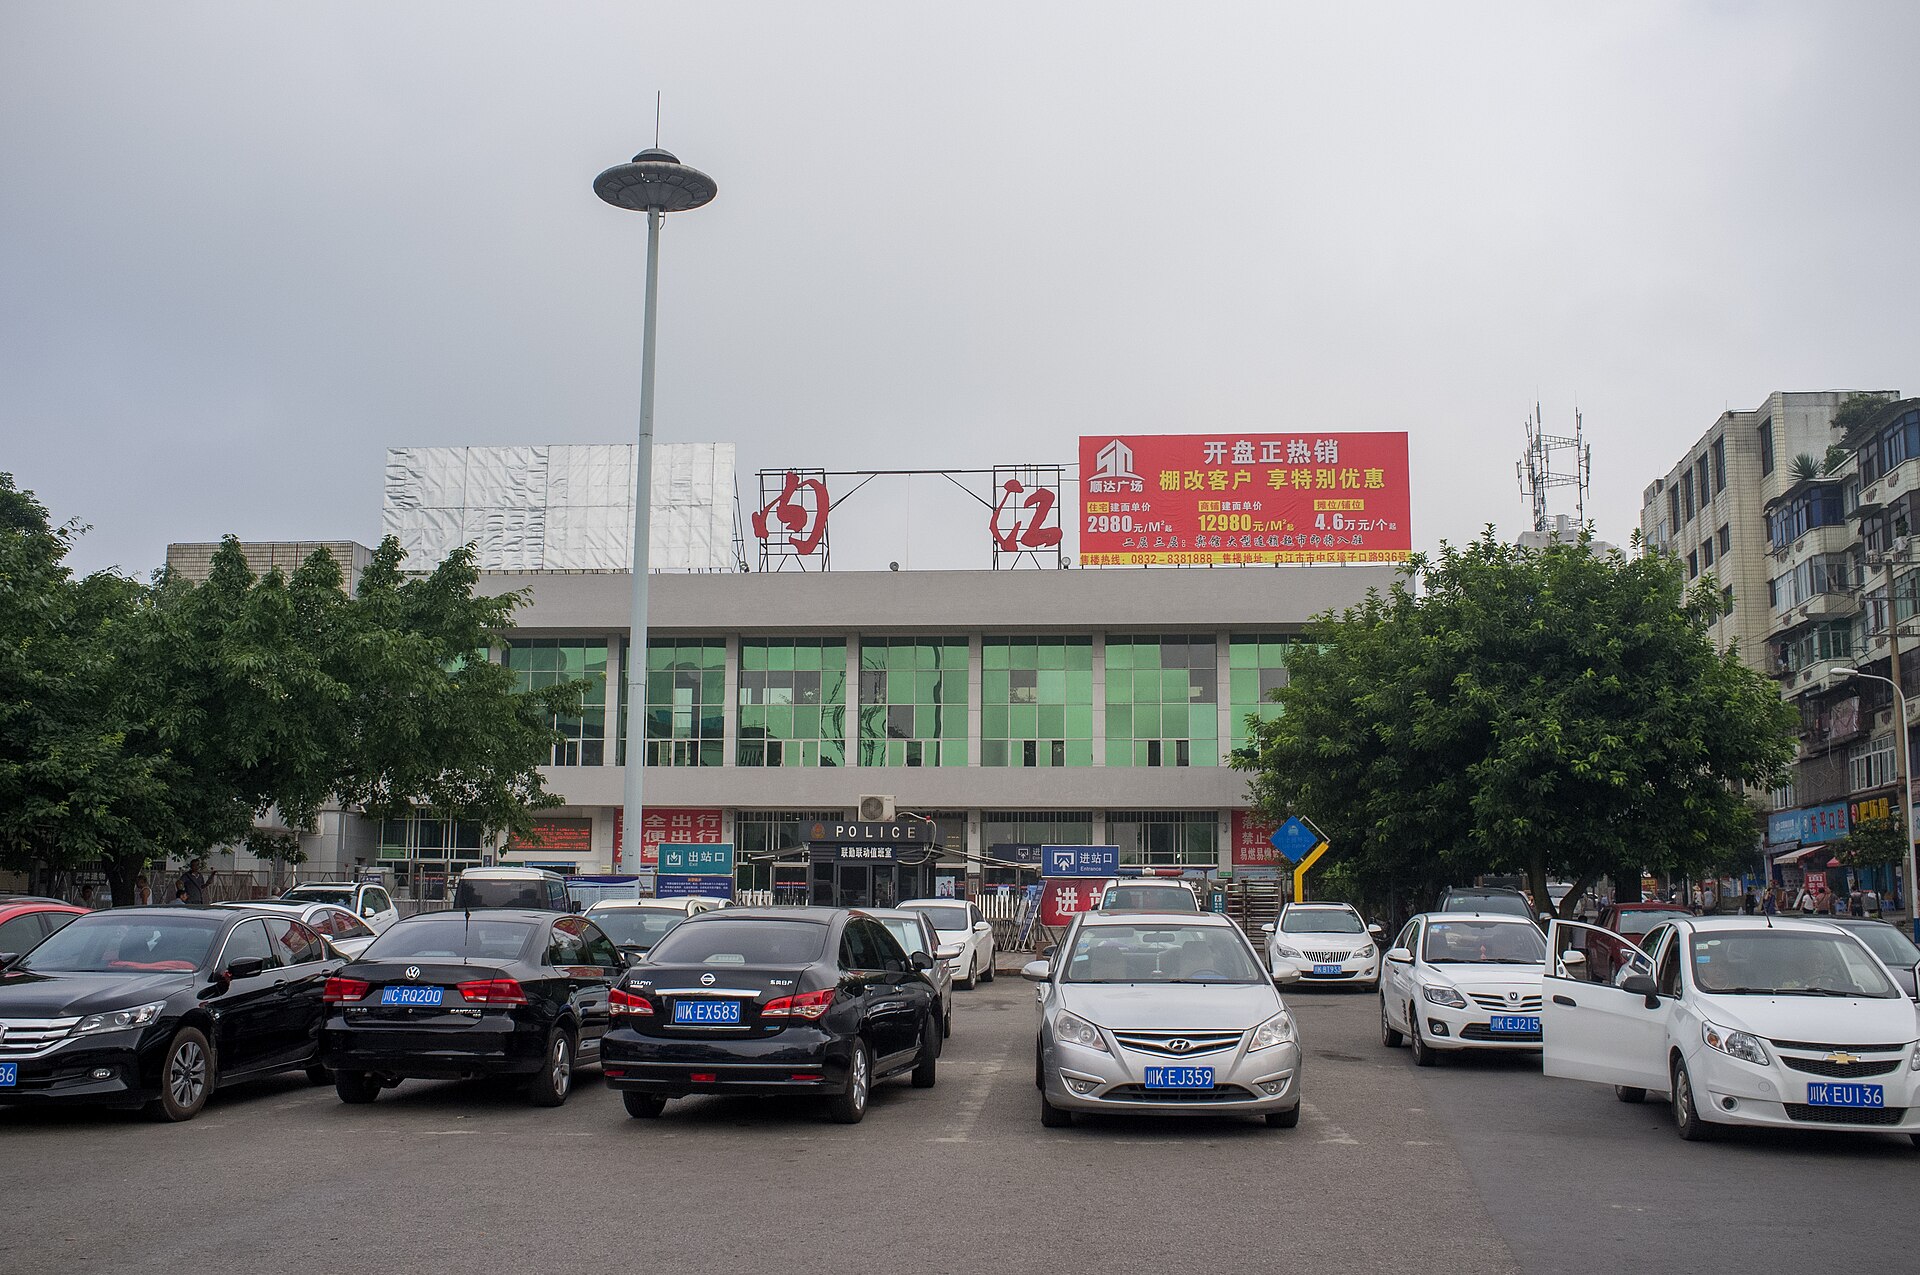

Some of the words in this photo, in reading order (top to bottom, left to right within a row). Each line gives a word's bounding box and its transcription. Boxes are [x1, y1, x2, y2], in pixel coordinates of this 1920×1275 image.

[1204, 438, 1338, 464] 开盘正热销
[1159, 469, 1251, 491] 棚改客户
[1266, 468, 1385, 490] 享特别优惠
[1089, 480, 1143, 493] 顺达广场
[1088, 503, 1108, 512] 住宅
[1110, 502, 1151, 512] 建面单价
[1200, 501, 1220, 511] 商铺
[1222, 501, 1262, 511] 建面单价
[836, 826, 916, 838] POLICE
[1242, 832, 1266, 845] 禁止
[688, 851, 724, 862] 出站口
[841, 847, 892, 858] 联勤联动值班室
[1080, 852, 1112, 864] 进站口
